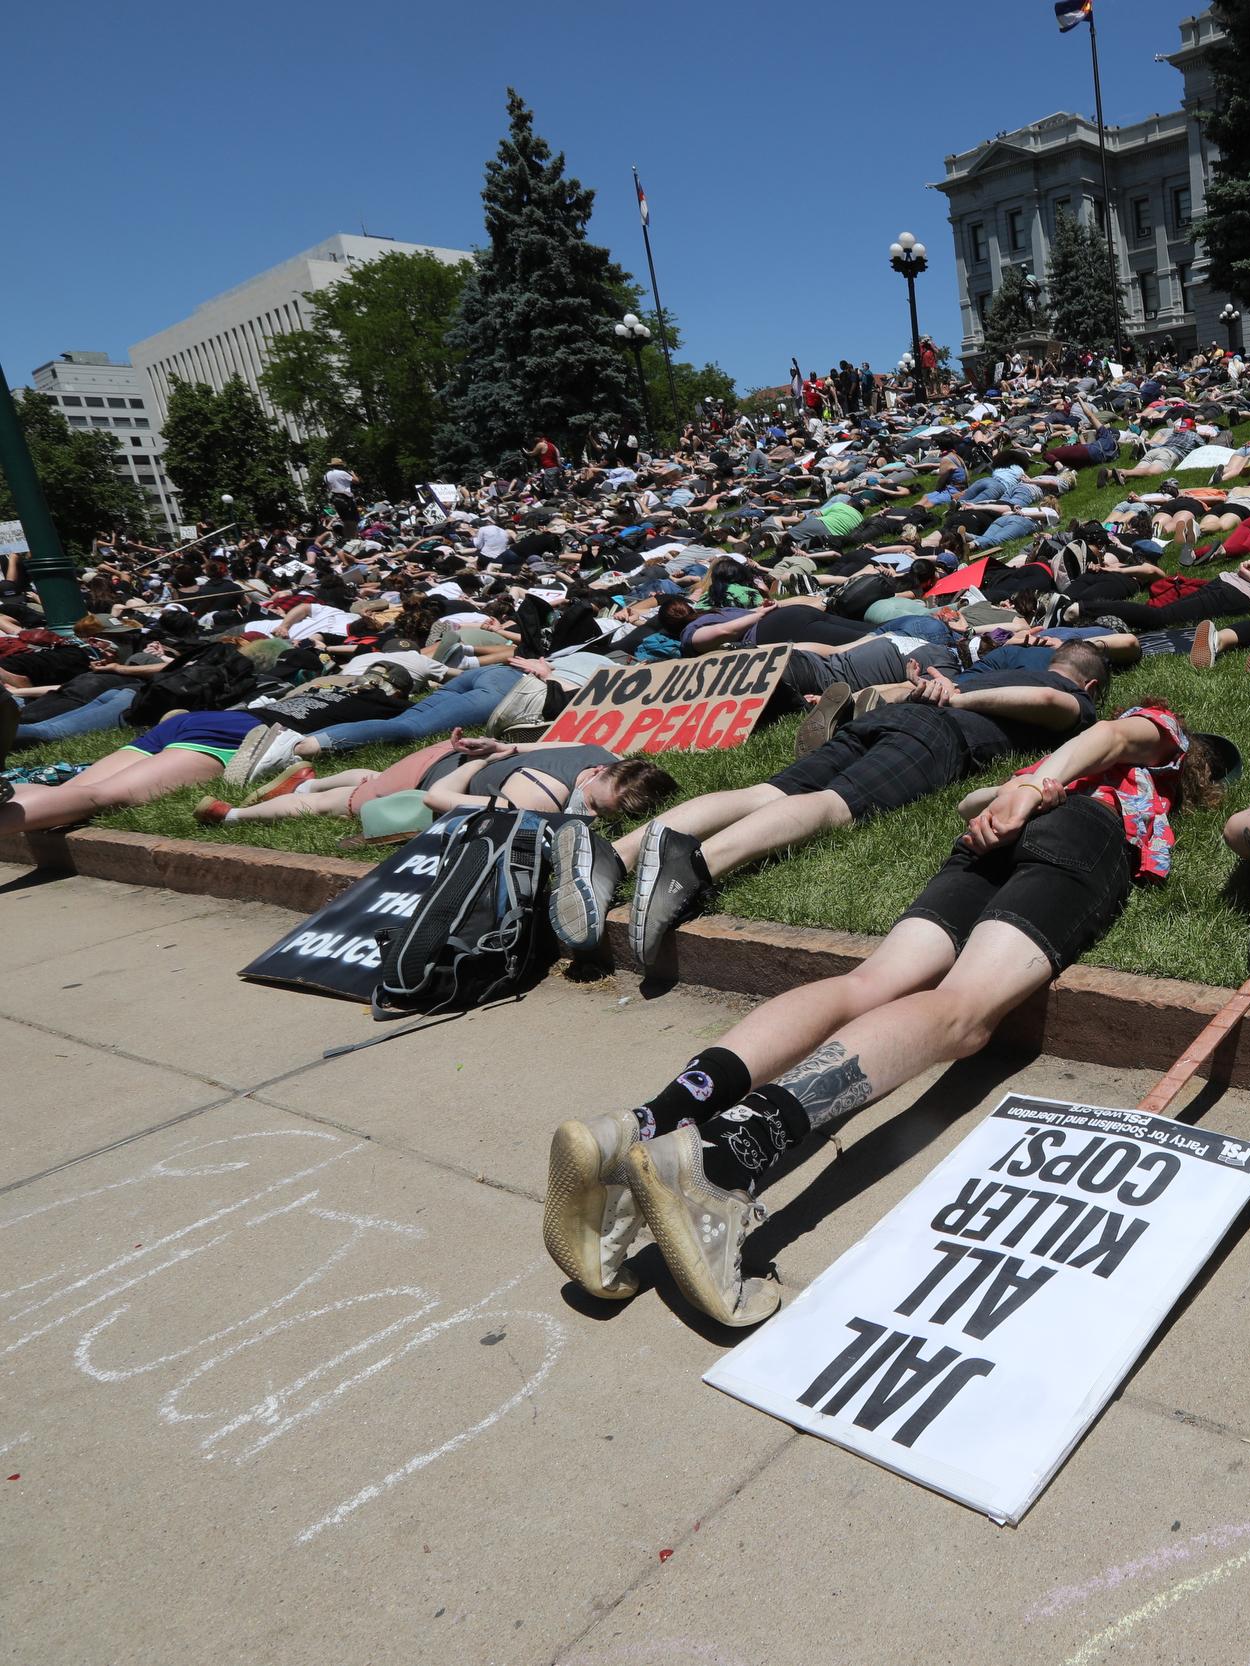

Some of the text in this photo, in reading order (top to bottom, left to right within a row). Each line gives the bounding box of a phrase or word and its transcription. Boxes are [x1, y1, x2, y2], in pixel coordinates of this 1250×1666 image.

[573, 646, 787, 706] NO JUSTICE
[543, 697, 765, 753] NO PEACE
[988, 1127, 1181, 1206] COPS!
[1007, 1106, 1209, 1157] Party for Socialism and Liberation
[930, 1178, 1150, 1279] KILLER
[893, 1240, 1059, 1341] ALL
[796, 1316, 996, 1448] JAIL
